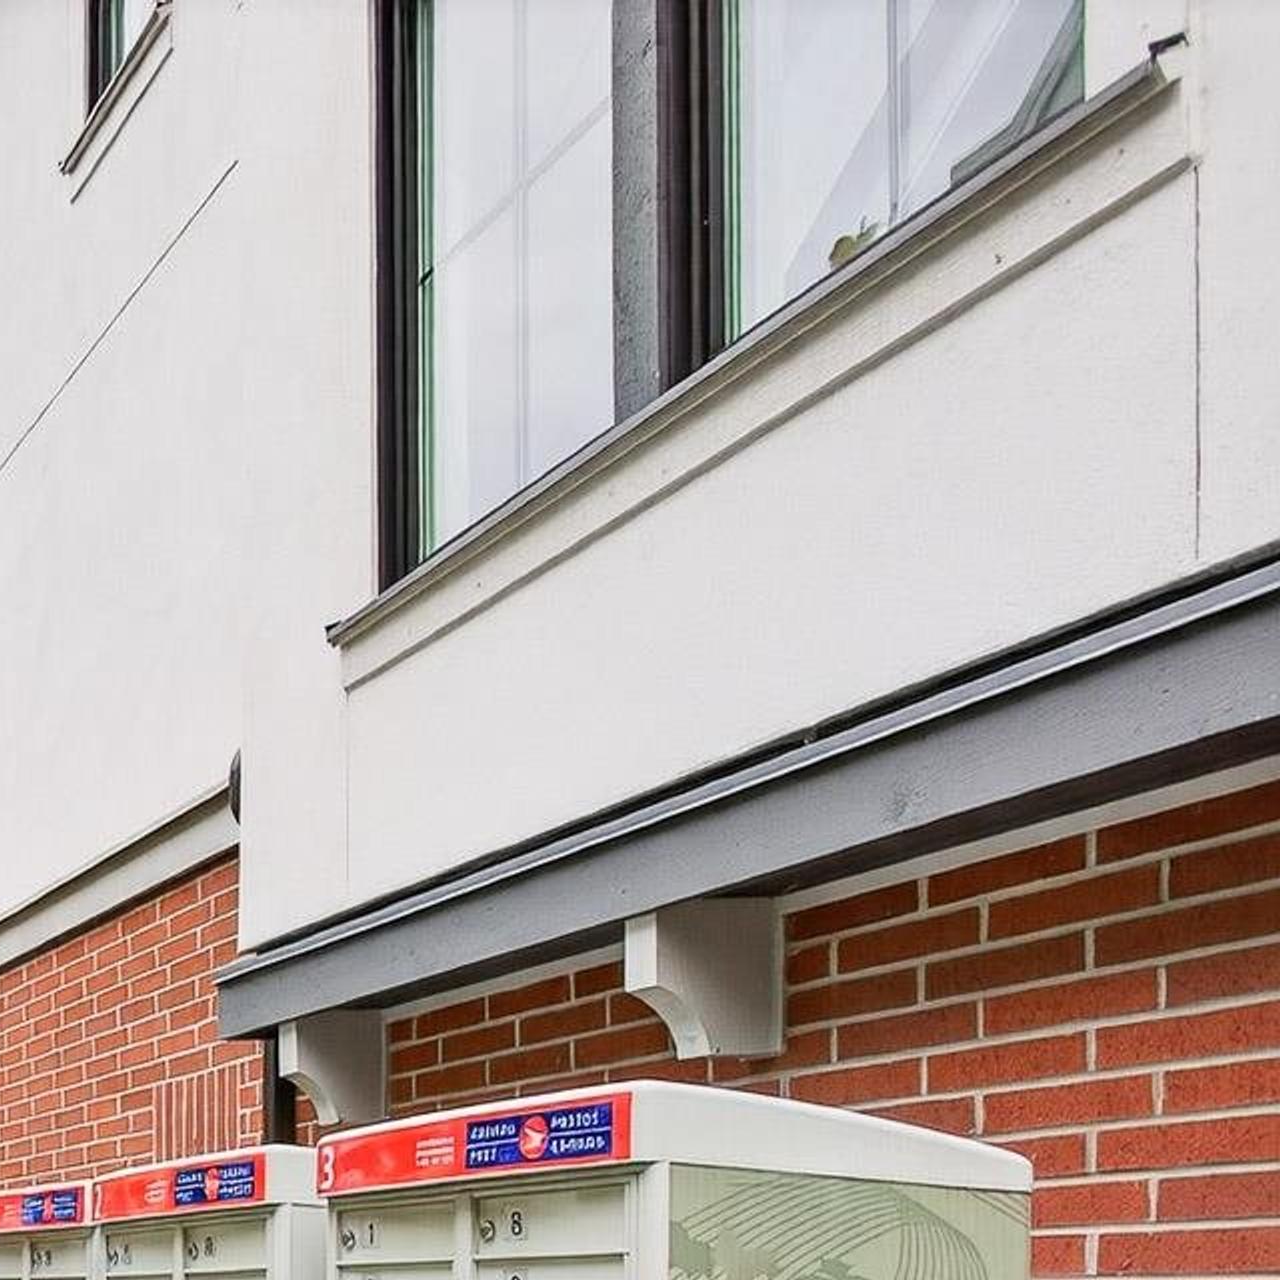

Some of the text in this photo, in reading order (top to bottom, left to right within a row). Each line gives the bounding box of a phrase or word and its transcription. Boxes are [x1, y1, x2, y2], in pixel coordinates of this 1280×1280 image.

[320, 1144, 335, 1190] 3
[368, 1222, 375, 1246] 1
[510, 1211, 523, 1236] 8
